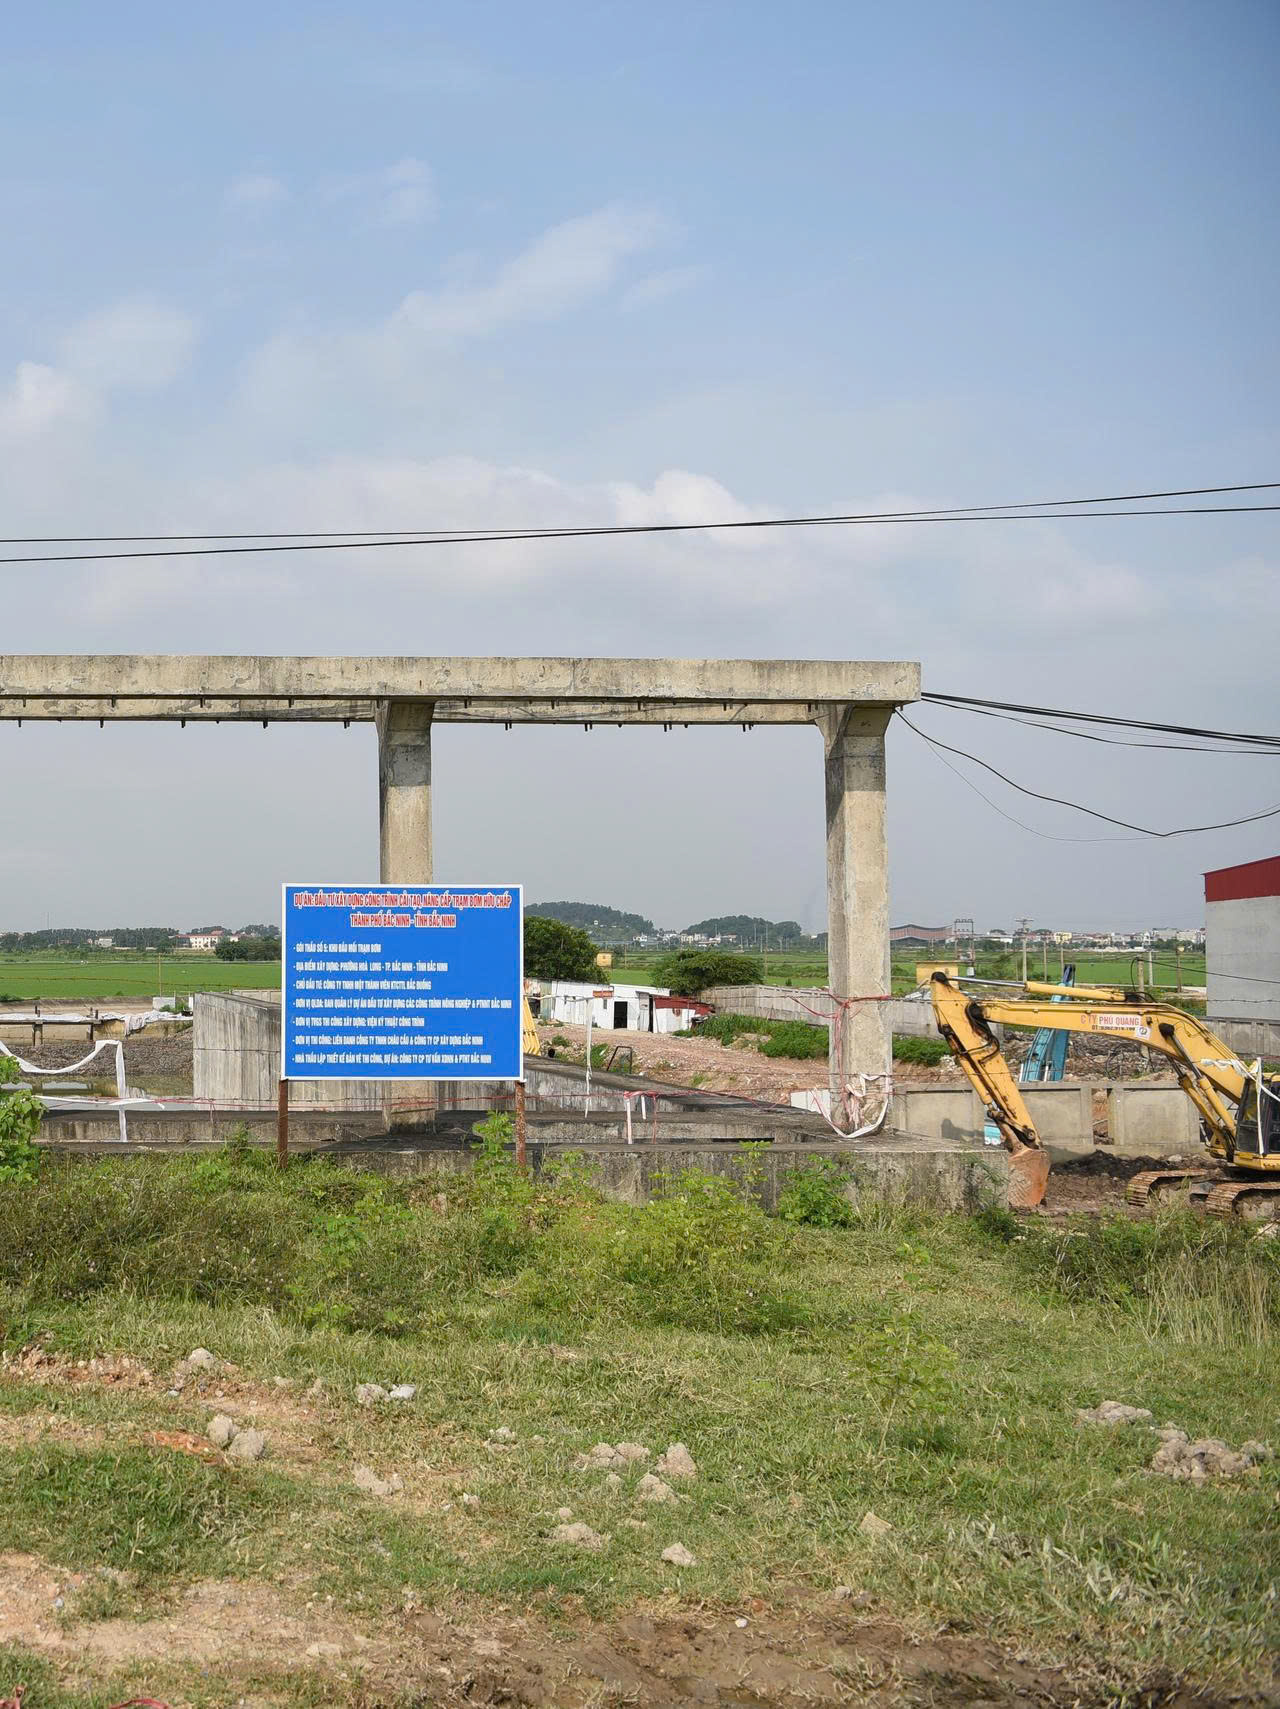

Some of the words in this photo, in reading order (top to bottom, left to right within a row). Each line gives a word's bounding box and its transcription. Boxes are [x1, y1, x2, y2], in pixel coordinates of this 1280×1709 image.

[294, 892, 303, 909] DỰ
[315, 889, 326, 906] ĐẦU
[328, 892, 336, 906] TƯ
[336, 890, 346, 906] XÂY
[348, 892, 363, 909] DỰNG
[365, 891, 380, 907] CÔNG
[381, 891, 398, 907] TRÌNH
[399, 890, 409, 907] CẢI
[423, 892, 439, 907] NÂNG
[440, 890, 452, 908] CẤP
[452, 894, 468, 910] TRẠM
[469, 894, 482, 908] BƠM
[496, 891, 512, 908] CHẤP
[350, 912, 370, 927] THÀNH
[370, 910, 382, 927] PHỐ
[383, 910, 395, 927] BẮC
[395, 914, 410, 927] NINH
[414, 910, 428, 928] TỈNH
[428, 910, 440, 928] BẮC
[440, 914, 456, 928] NINH
[1088, 1014, 1097, 1024] TY
[1099, 1014, 1113, 1024] PHÚ
[1116, 1017, 1139, 1026] QUANG
